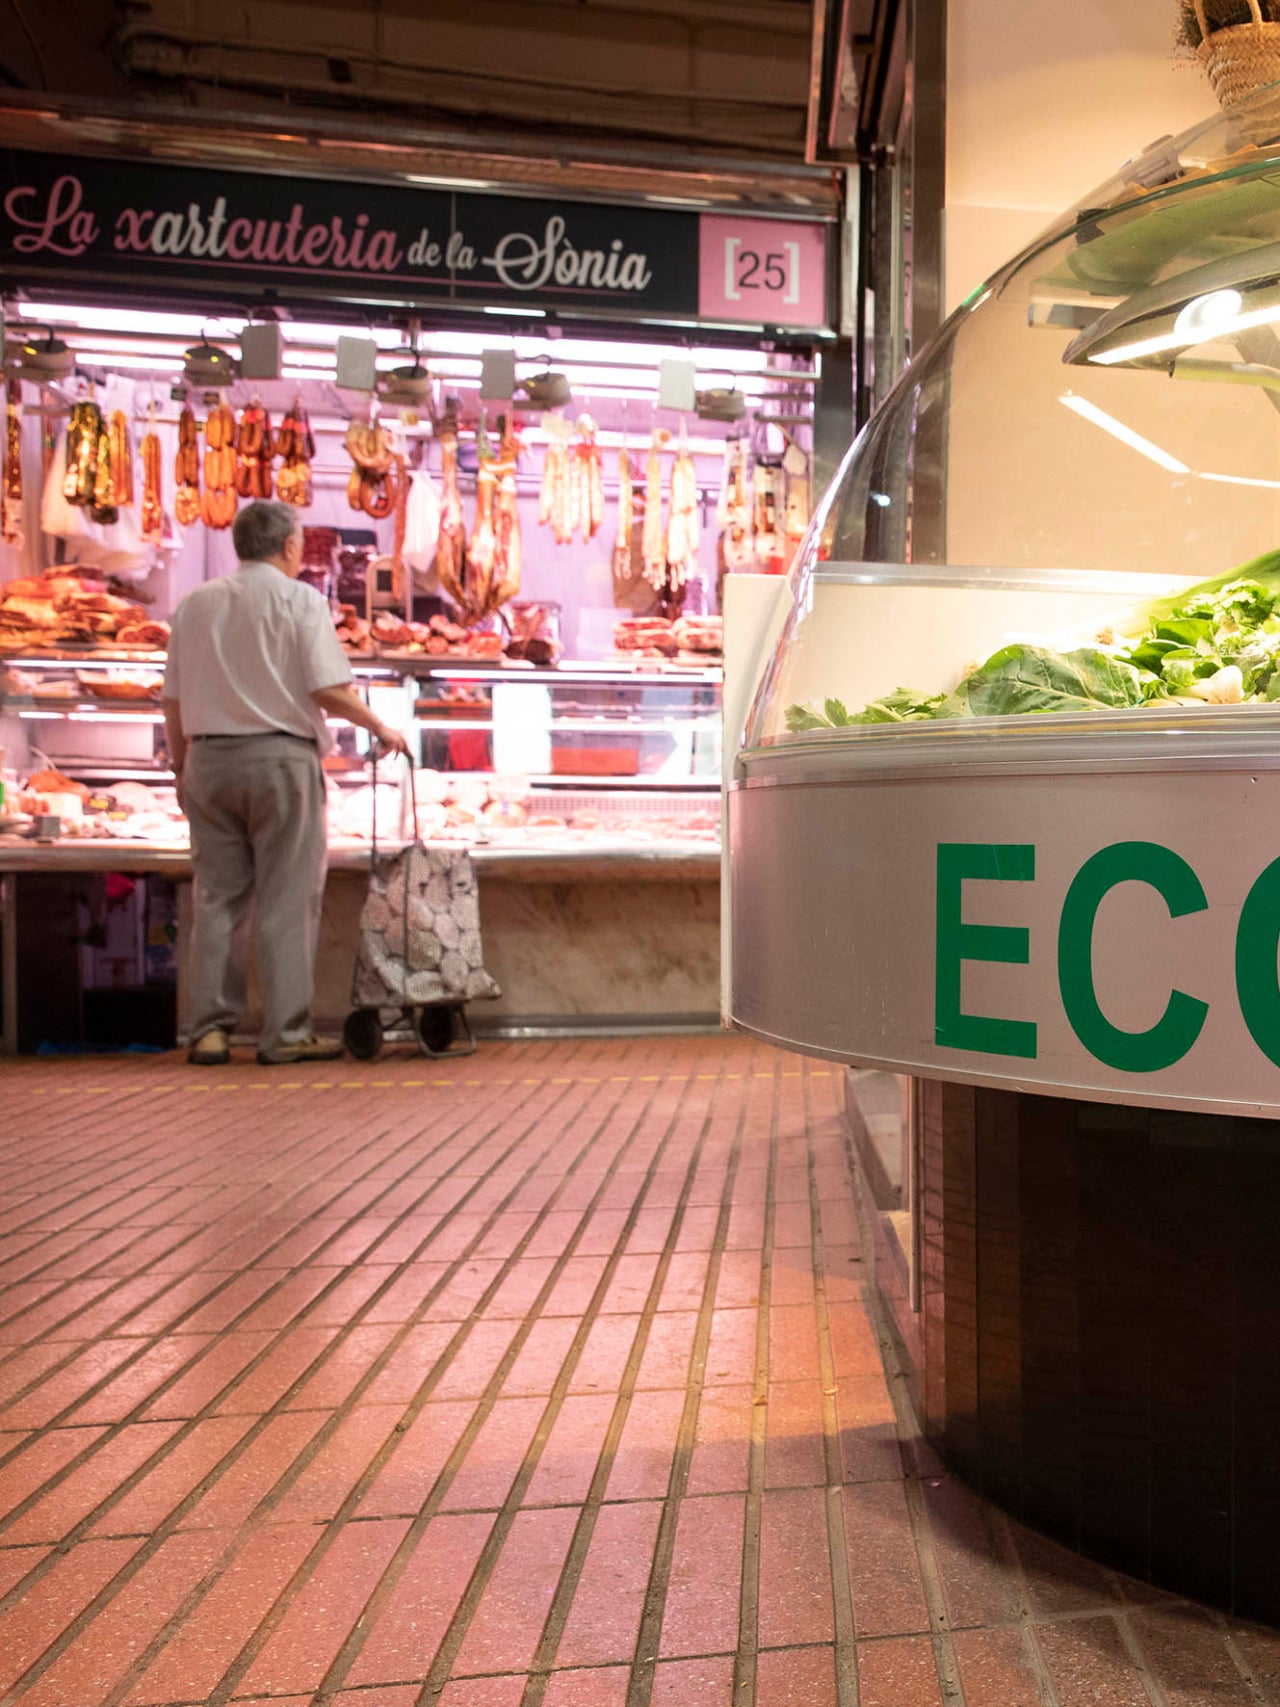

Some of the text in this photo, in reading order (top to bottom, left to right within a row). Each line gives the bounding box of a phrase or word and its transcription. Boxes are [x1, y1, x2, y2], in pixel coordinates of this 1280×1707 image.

[4, 174, 652, 291] La xartcuteria de la Sònia
